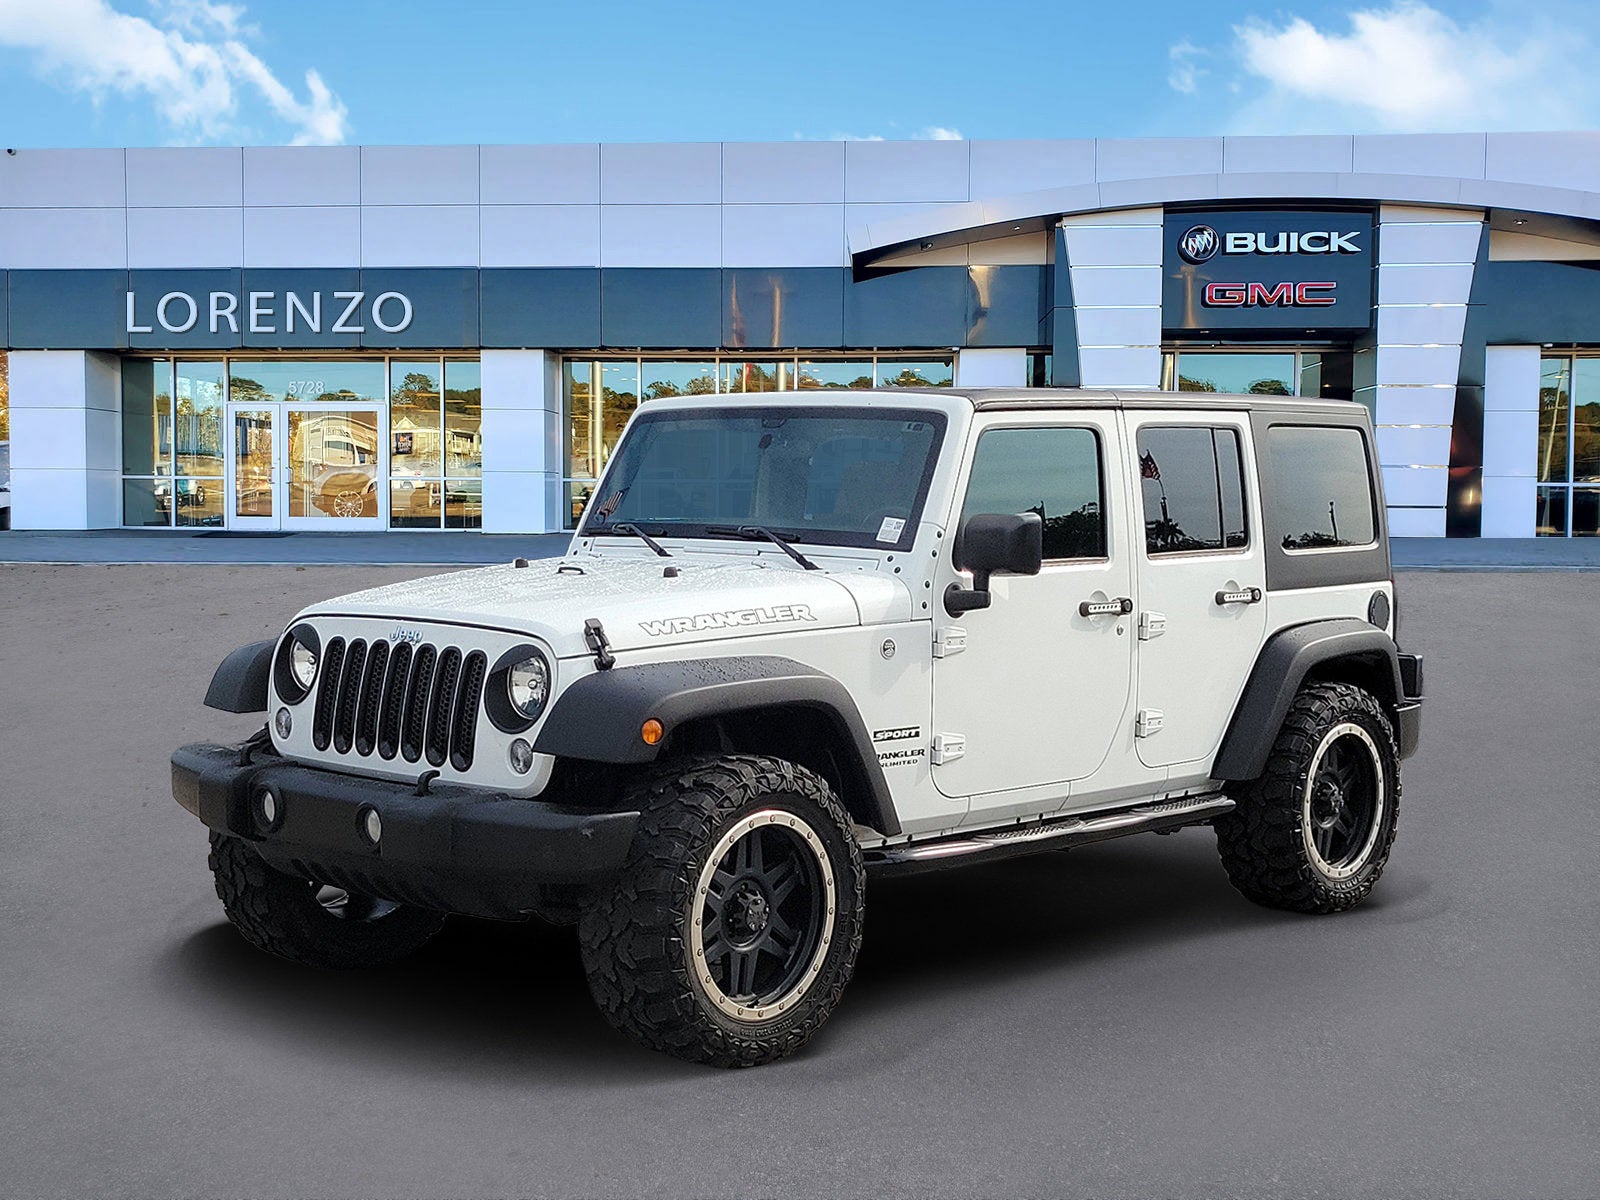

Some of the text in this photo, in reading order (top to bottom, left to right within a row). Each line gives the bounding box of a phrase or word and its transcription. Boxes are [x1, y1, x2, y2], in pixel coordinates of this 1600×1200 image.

[1224, 231, 1362, 254] BUICK
[1204, 281, 1337, 306] GMC
[126, 291, 413, 333] LORENZO
[288, 381, 325, 394] 5728
[639, 604, 818, 636] WRANGLER
[390, 625, 423, 646] Jeep
[874, 728, 919, 741] SPORT
[876, 748, 925, 760] ANGLER
